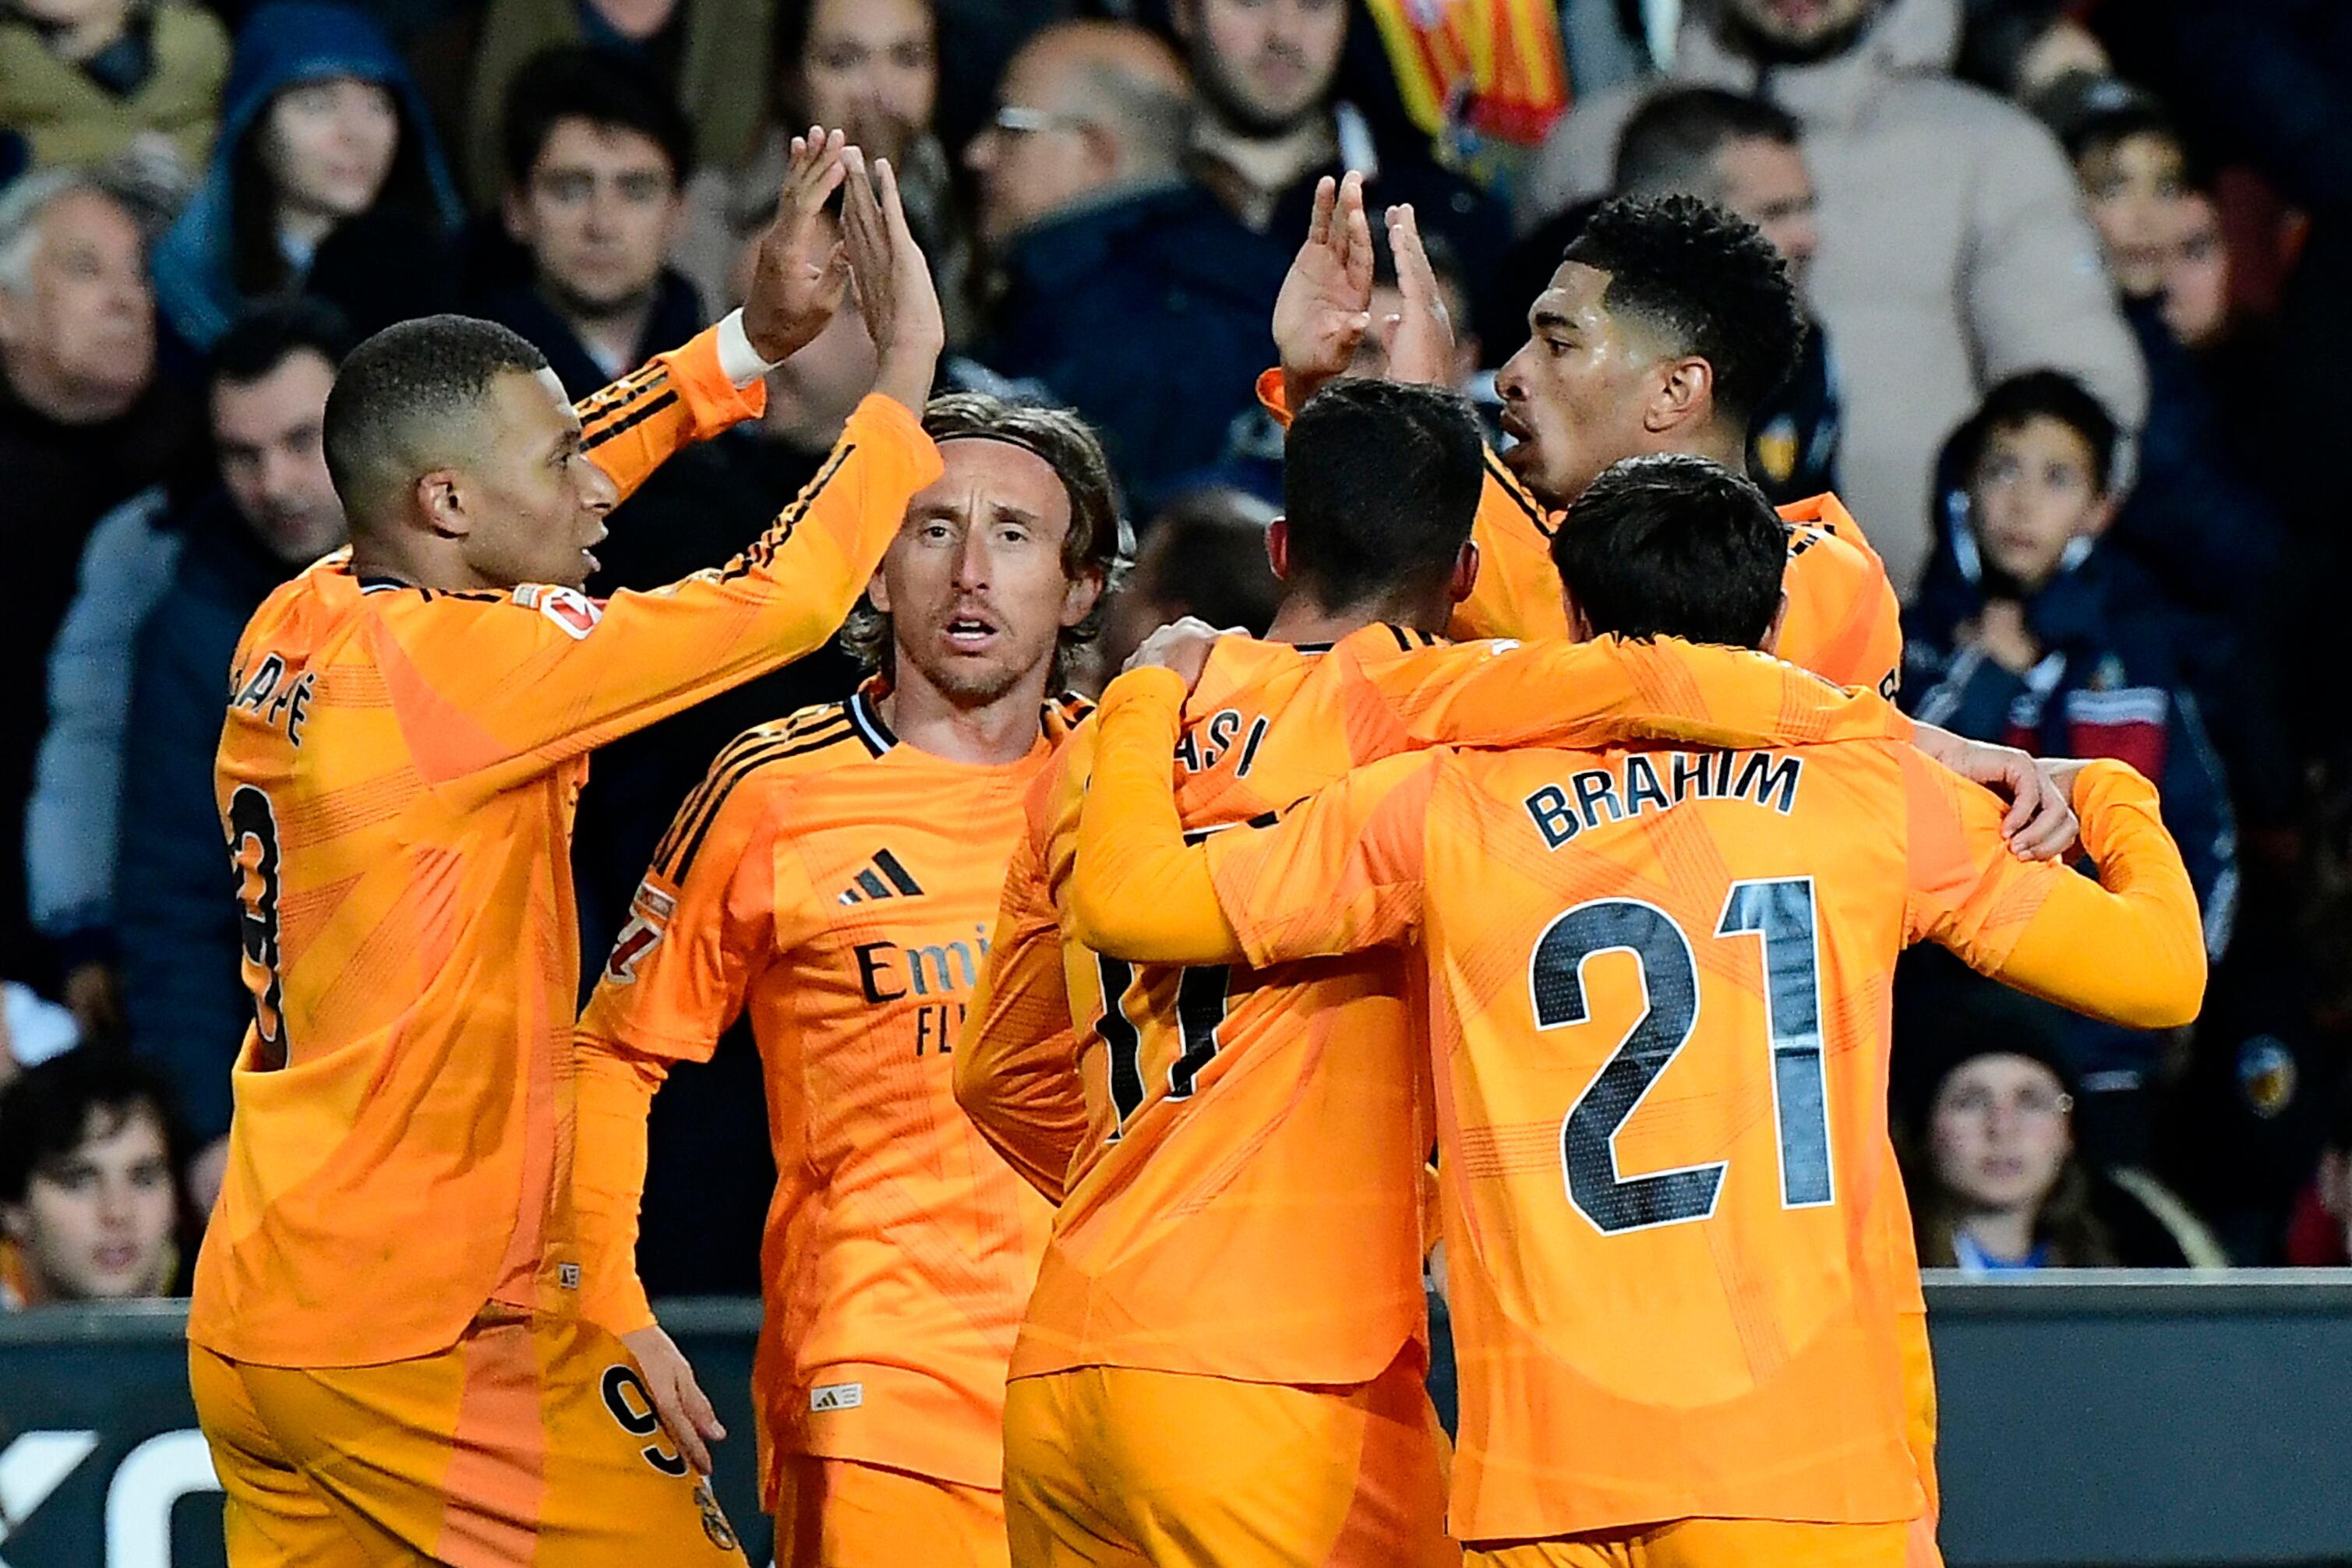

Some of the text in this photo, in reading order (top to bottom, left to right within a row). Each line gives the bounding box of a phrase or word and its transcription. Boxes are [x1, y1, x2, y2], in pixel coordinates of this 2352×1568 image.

[1524, 750, 1803, 851] BRAHIM
[916, 1002, 966, 1057] FL
[1527, 875, 1835, 1236] 21
[599, 1364, 689, 1478] 9
